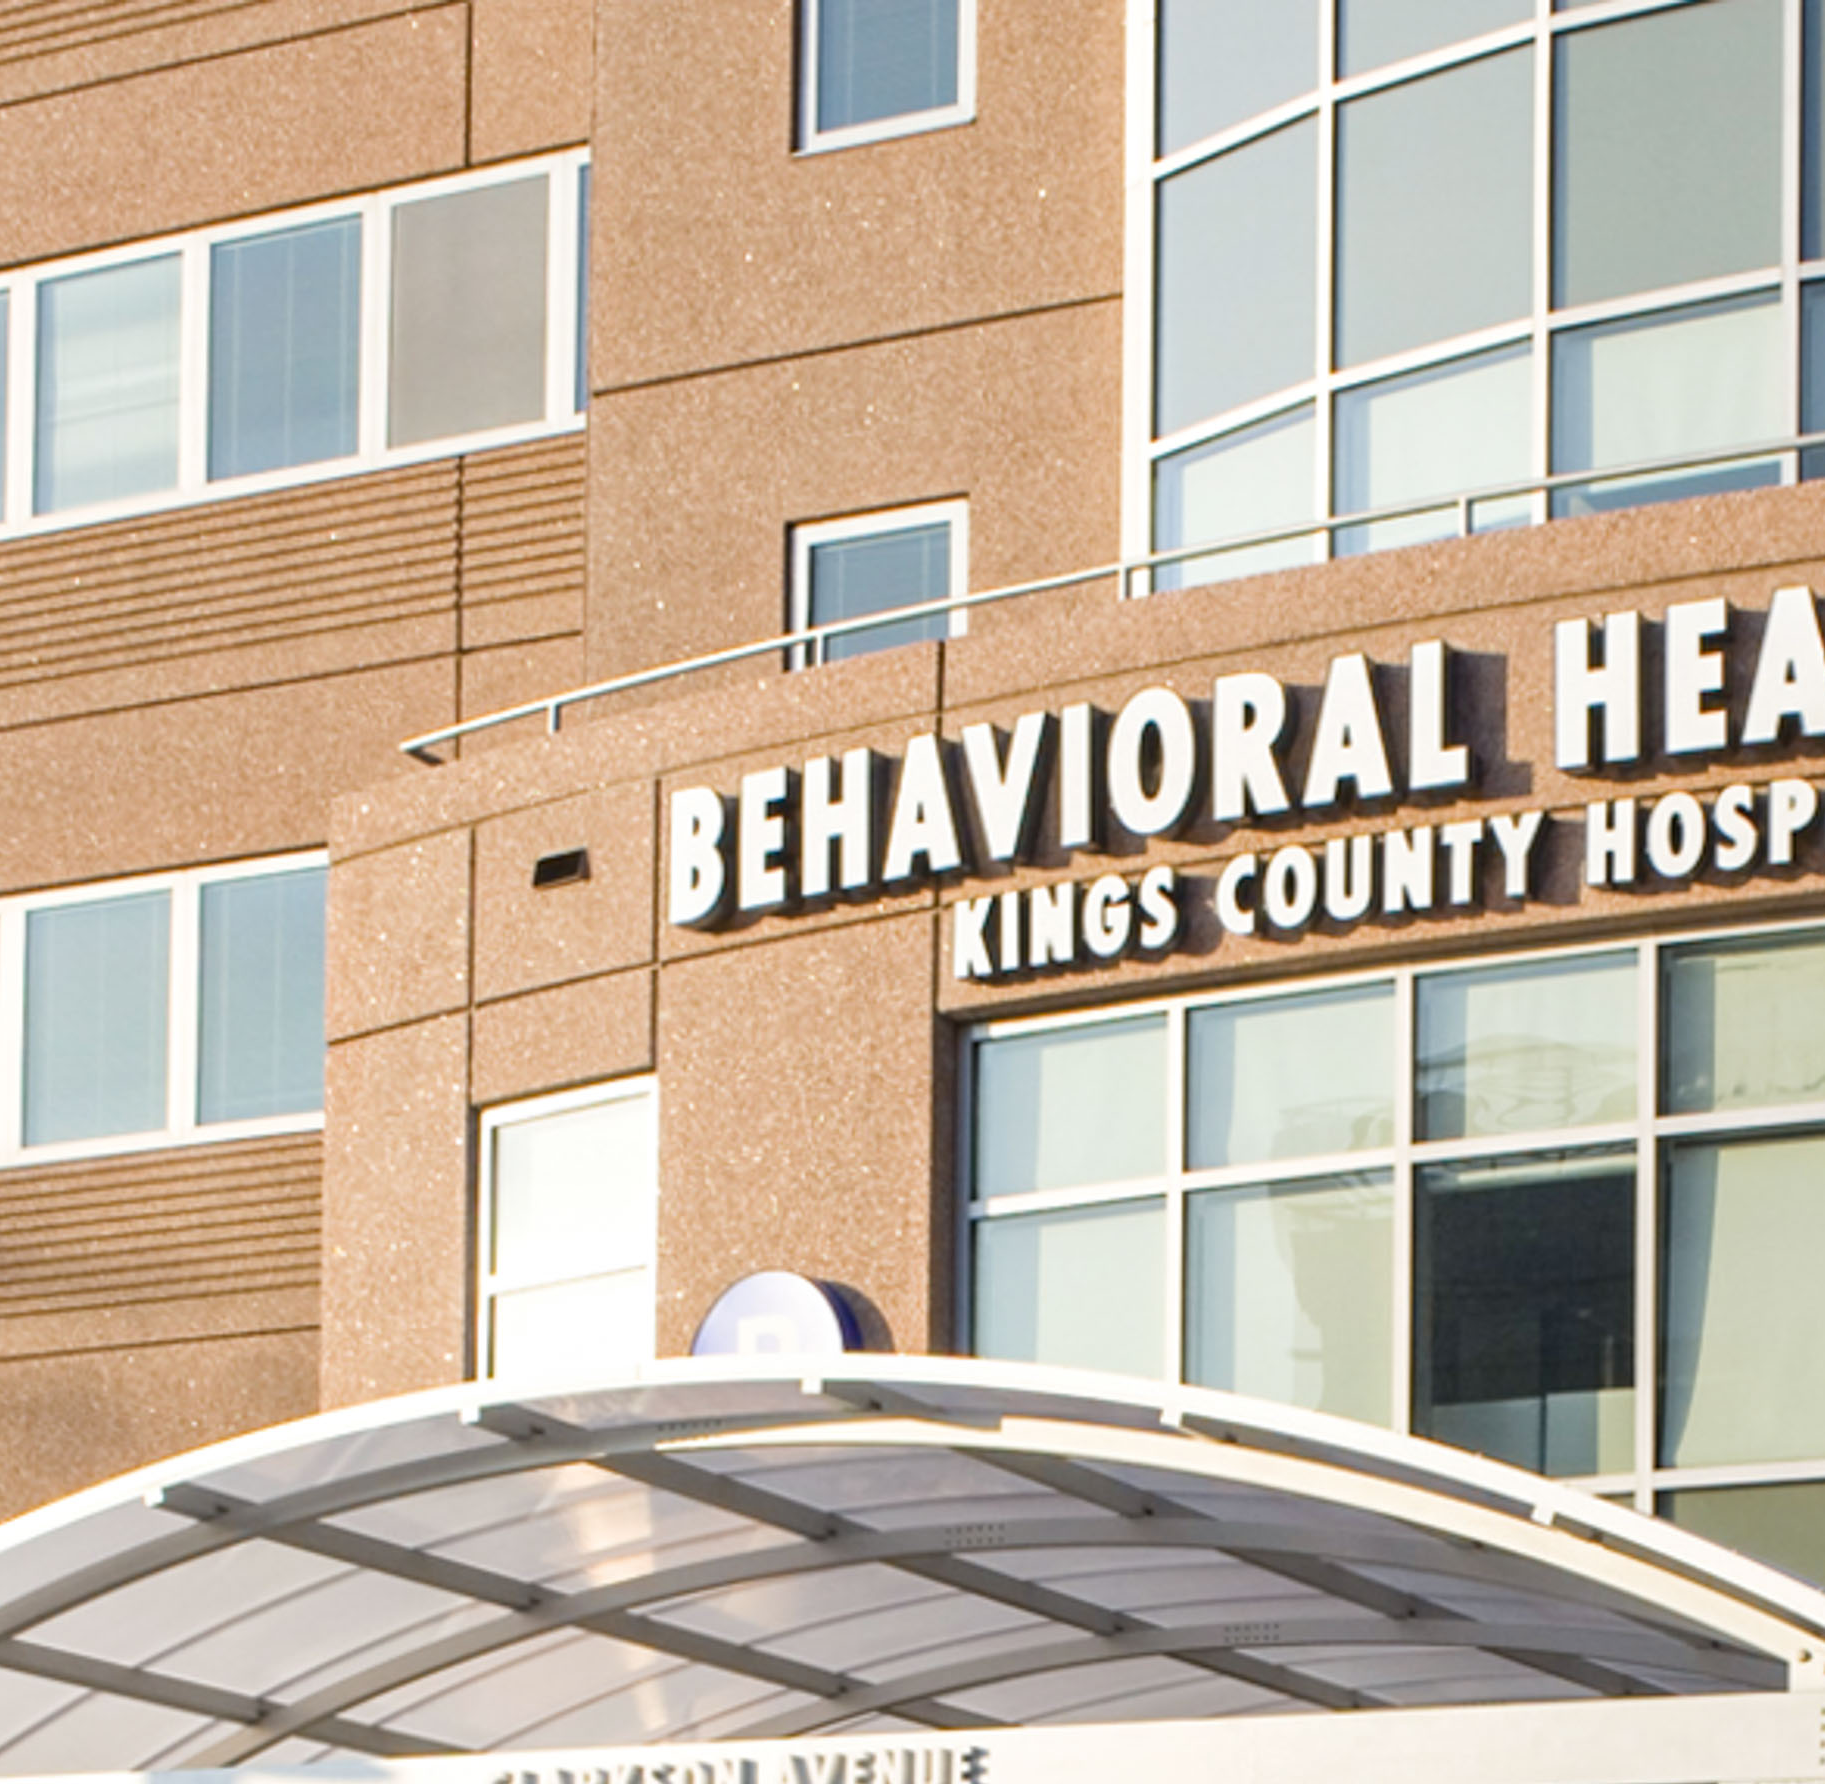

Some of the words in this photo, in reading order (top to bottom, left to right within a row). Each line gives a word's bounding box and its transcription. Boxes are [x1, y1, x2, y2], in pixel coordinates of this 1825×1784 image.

[666, 638, 1468, 927] BEHAVIORAL
[951, 864, 1177, 981] KINGS
[1214, 809, 1544, 938] COUNTY
